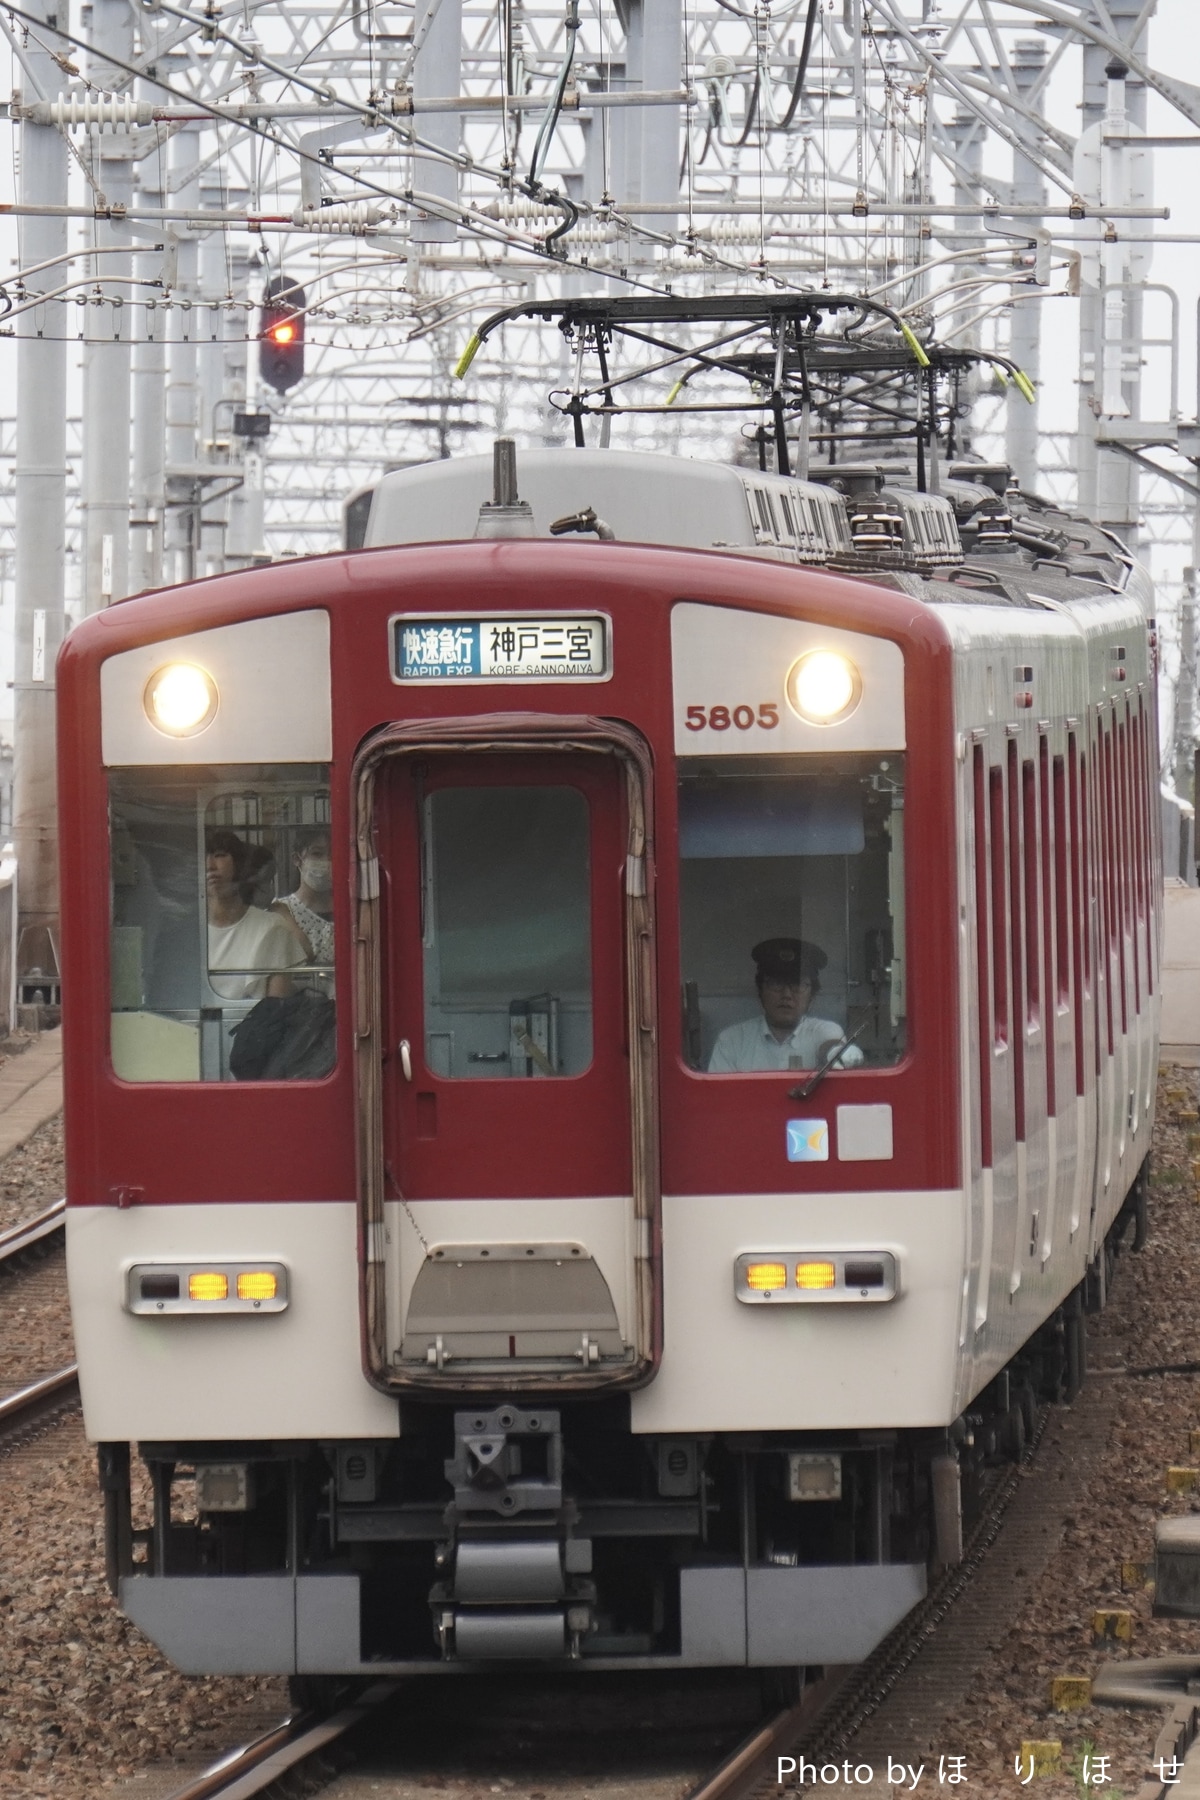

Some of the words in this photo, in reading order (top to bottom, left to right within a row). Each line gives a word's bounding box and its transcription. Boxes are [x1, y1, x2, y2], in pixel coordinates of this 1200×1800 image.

[403, 627, 474, 665] 快速急行
[490, 626, 593, 662] 神戸三宮
[403, 666, 441, 676] RAPID
[685, 704, 779, 731] 5805
